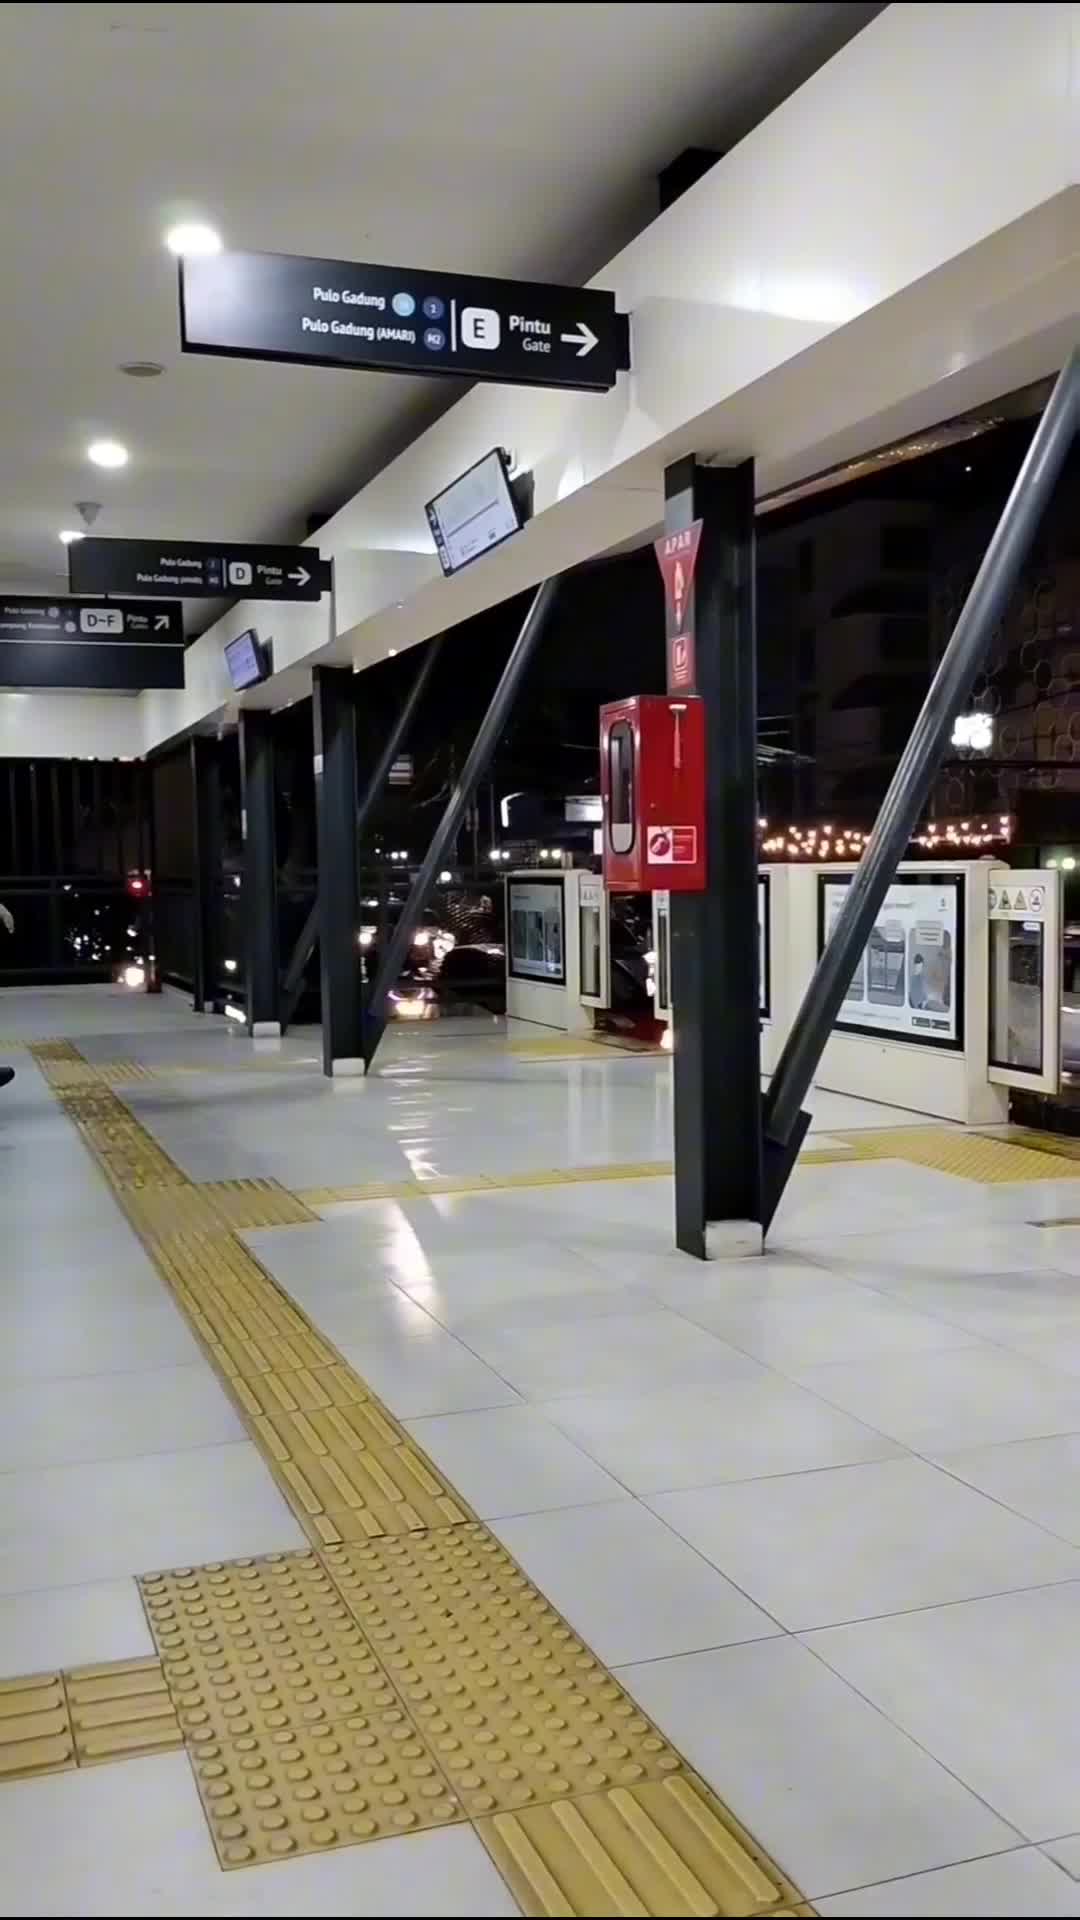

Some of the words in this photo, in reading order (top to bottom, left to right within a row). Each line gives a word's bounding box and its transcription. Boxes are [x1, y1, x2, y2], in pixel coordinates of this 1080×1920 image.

[313, 287, 340, 303] Pulo
[342, 290, 386, 311] Gadung
[302, 317, 329, 333] Pulo
[331, 320, 375, 341] Gadung
[473, 317, 485, 339] E
[509, 315, 551, 335] Pintu
[522, 338, 551, 353] Gate
[664, 531, 691, 555] APAR
[236, 567, 245, 579] D
